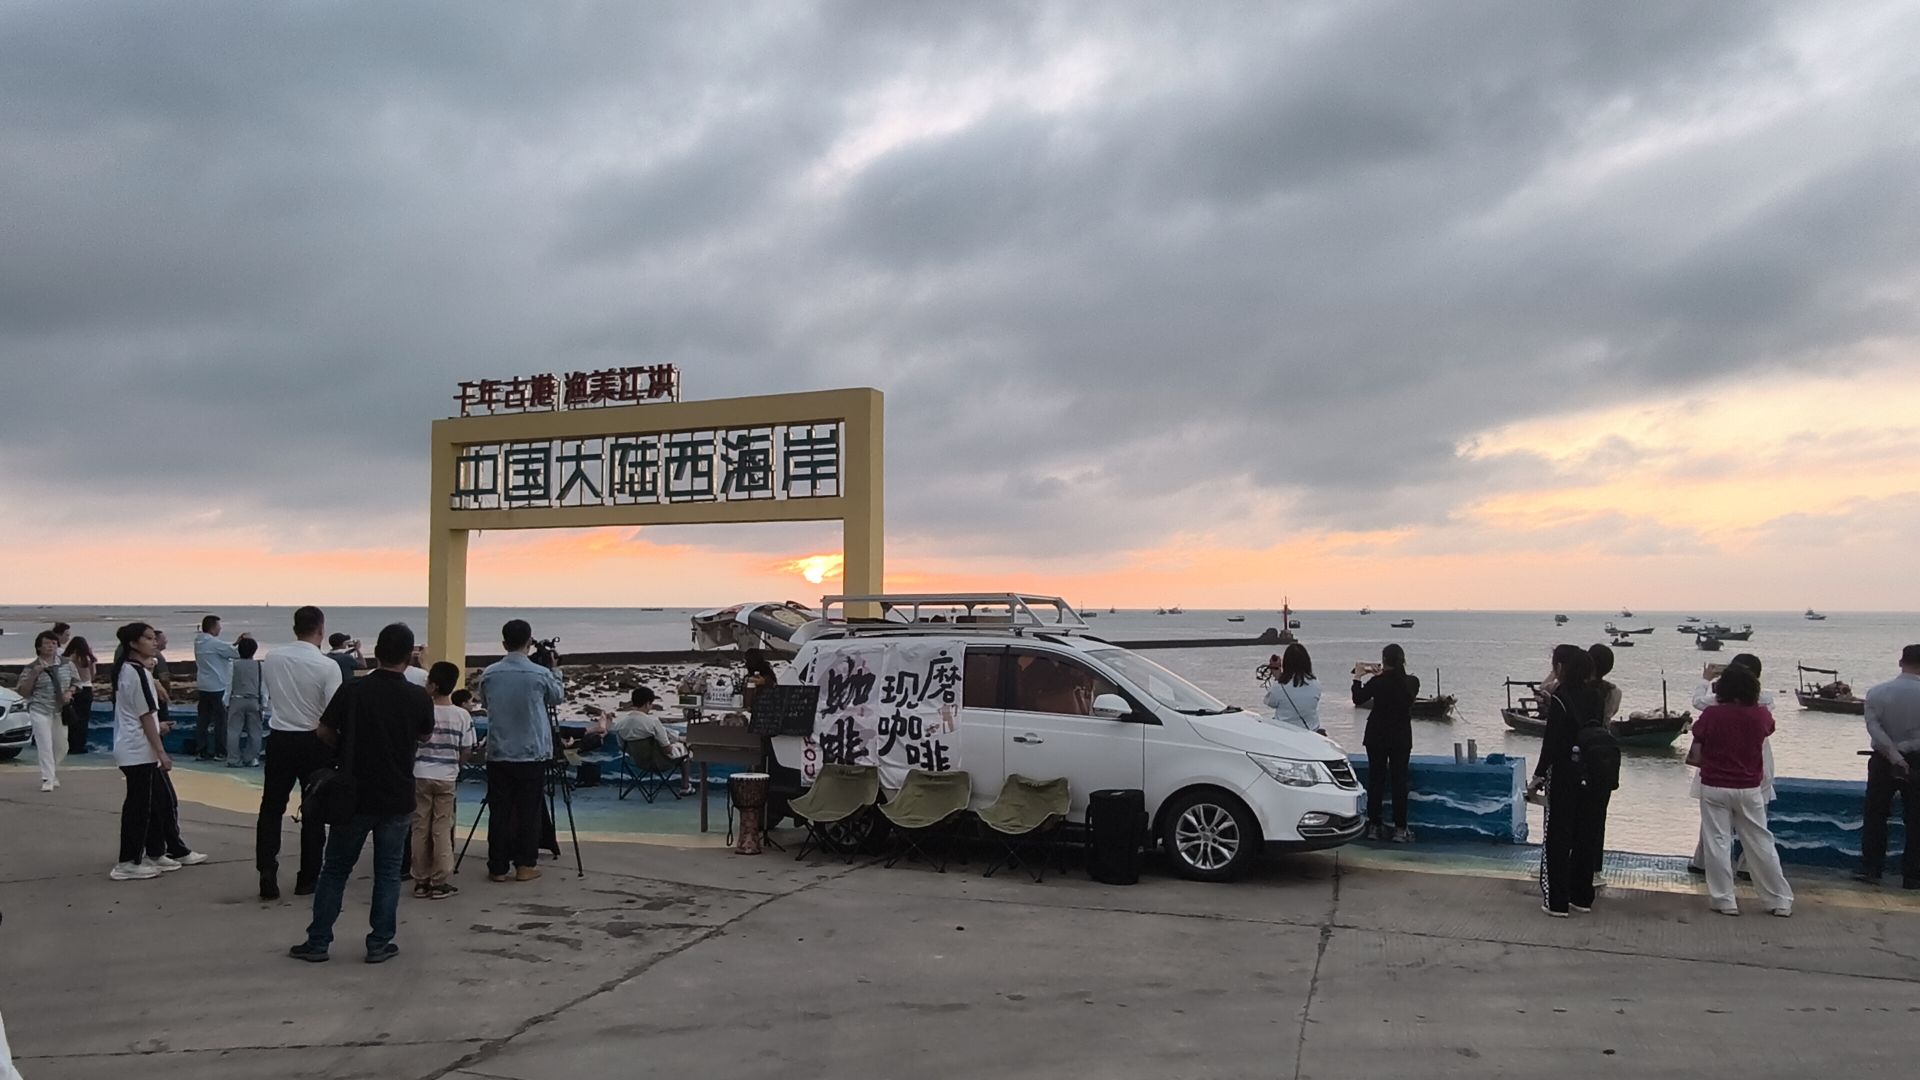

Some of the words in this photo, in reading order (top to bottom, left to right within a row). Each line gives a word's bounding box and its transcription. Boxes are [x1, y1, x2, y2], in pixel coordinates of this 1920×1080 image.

[453, 373, 557, 415] 千年古港
[456, 429, 838, 502] 中国大陆西海岸
